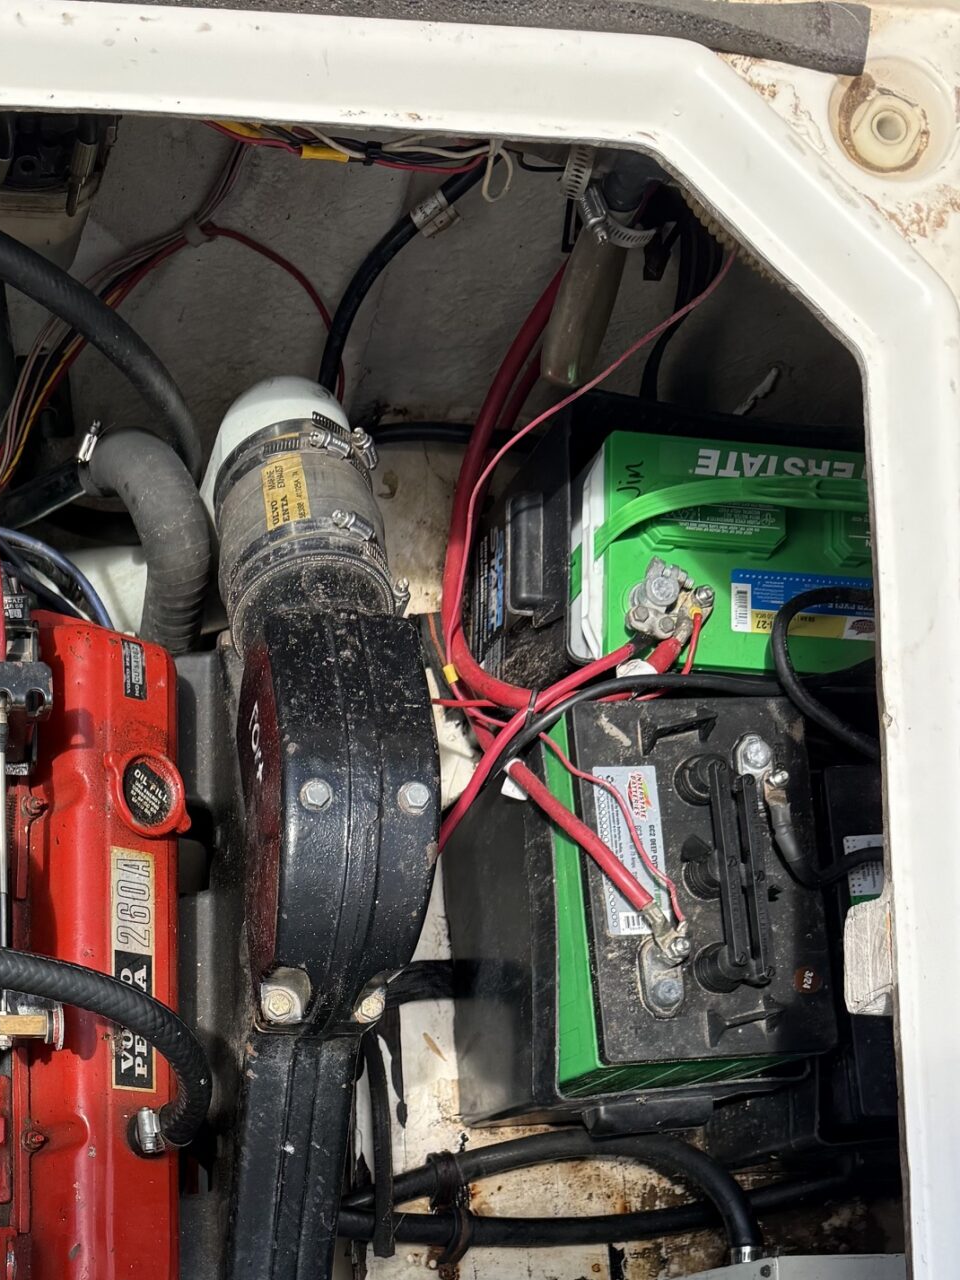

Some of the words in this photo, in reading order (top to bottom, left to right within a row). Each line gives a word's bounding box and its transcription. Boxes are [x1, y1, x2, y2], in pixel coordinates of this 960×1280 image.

[280, 494, 290, 522] ENTA
[132, 768, 150, 785] OIL
[148, 782, 170, 803] FILL
[630, 775, 638, 815] BATTERIES
[636, 773, 646, 818] INTERSTATE
[802, 970, 813, 988] 3/24
[120, 967, 132, 1072] VOO
[135, 964, 147, 1077] PEA
